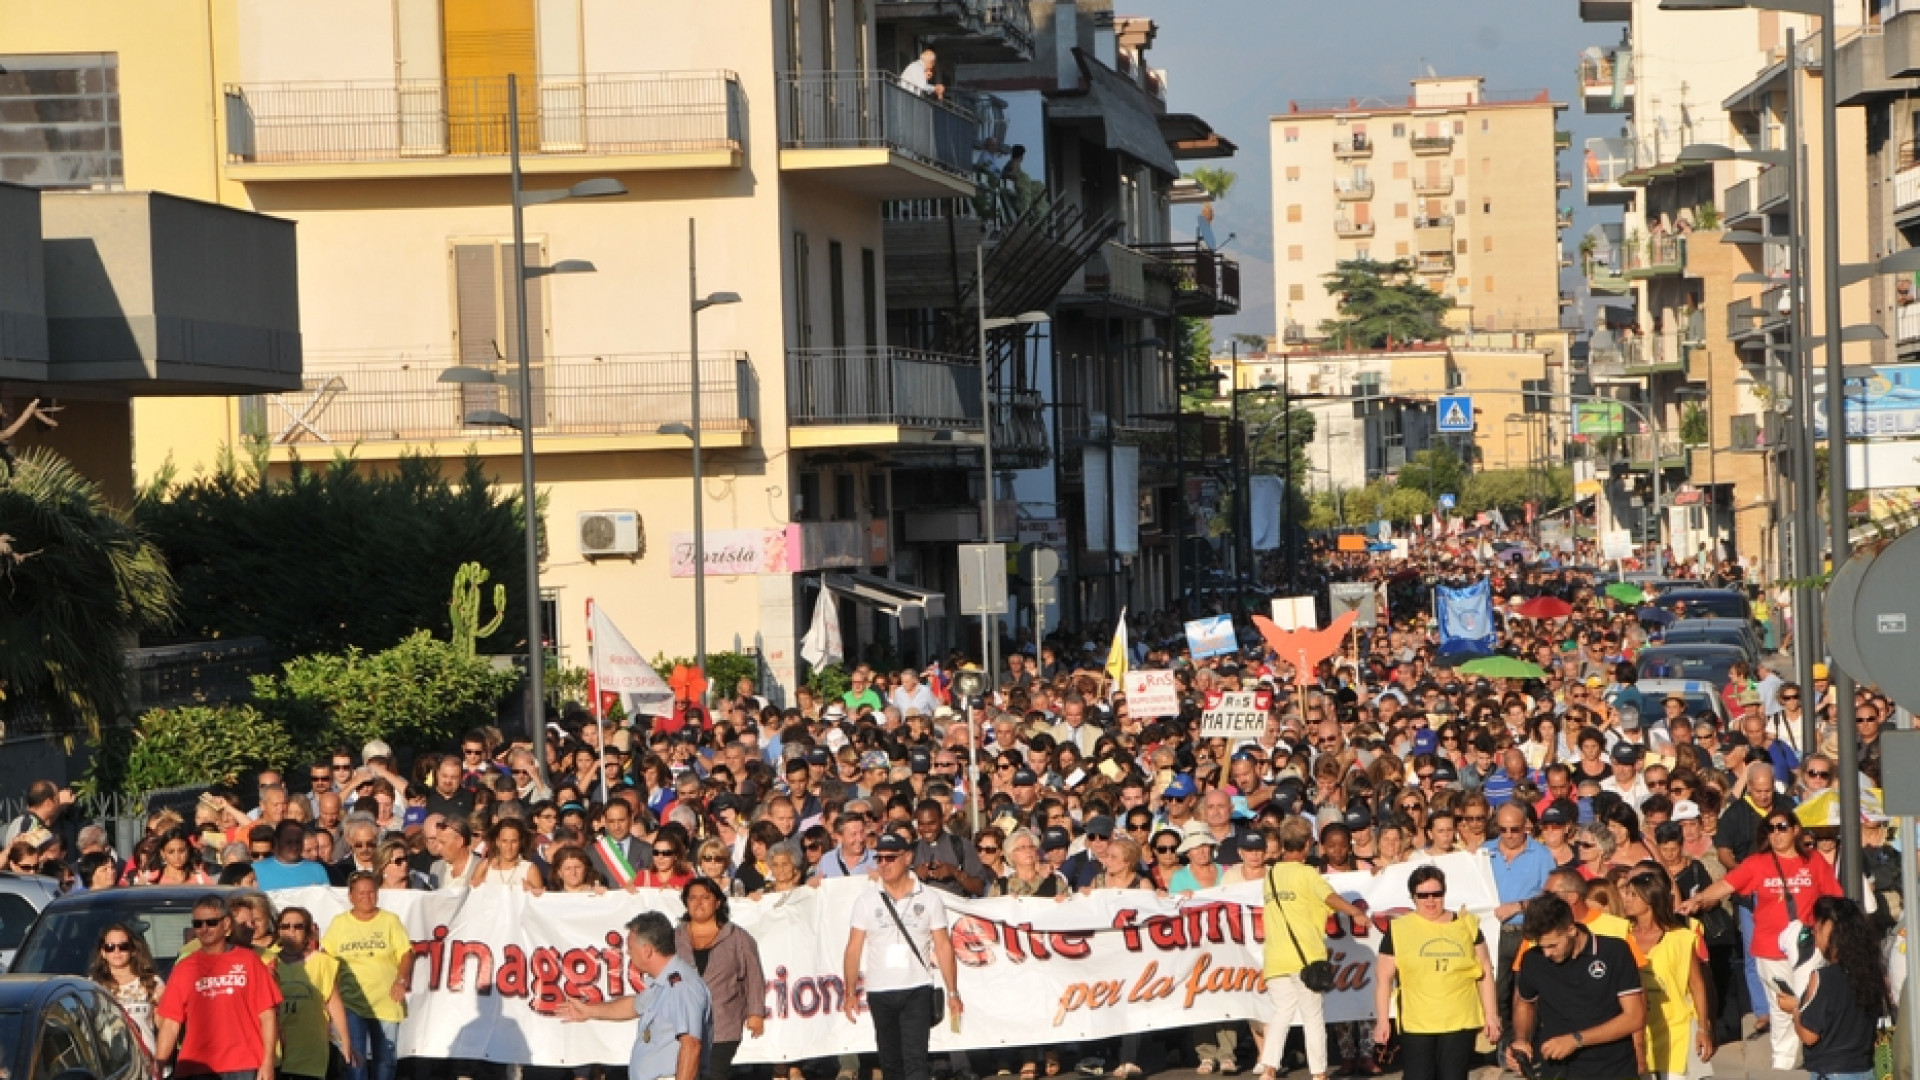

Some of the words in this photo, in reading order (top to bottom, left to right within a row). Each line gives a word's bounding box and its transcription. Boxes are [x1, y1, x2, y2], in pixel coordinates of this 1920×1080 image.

[1202, 712, 1265, 731] MATERA
[1435, 958, 1449, 972] 17
[1053, 975, 1126, 1027] per
[1127, 960, 1175, 1004] la
[1183, 947, 1372, 1010] famia
